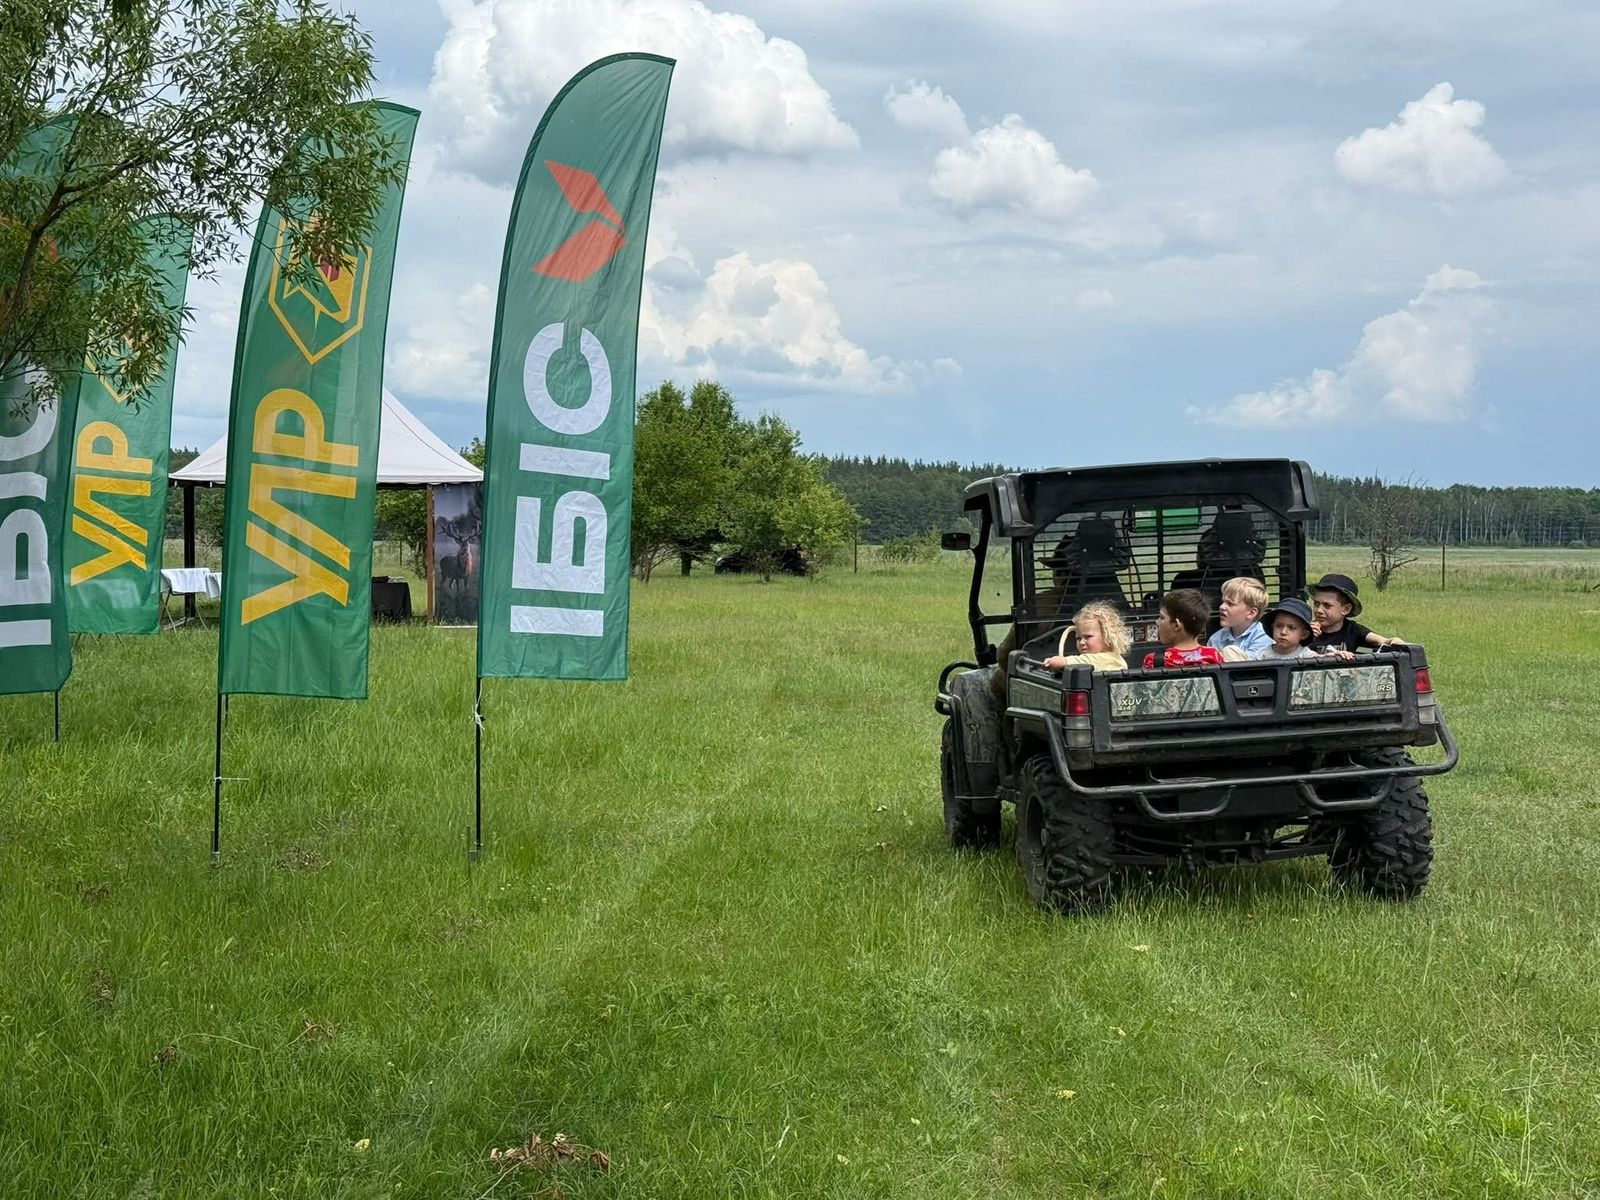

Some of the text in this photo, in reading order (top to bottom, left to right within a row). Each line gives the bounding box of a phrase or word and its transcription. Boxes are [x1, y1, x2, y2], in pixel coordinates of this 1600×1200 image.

[510, 322, 612, 637] ІБІС
[1376, 684, 1392, 692] IRS
[1121, 697, 1143, 706] XUV
